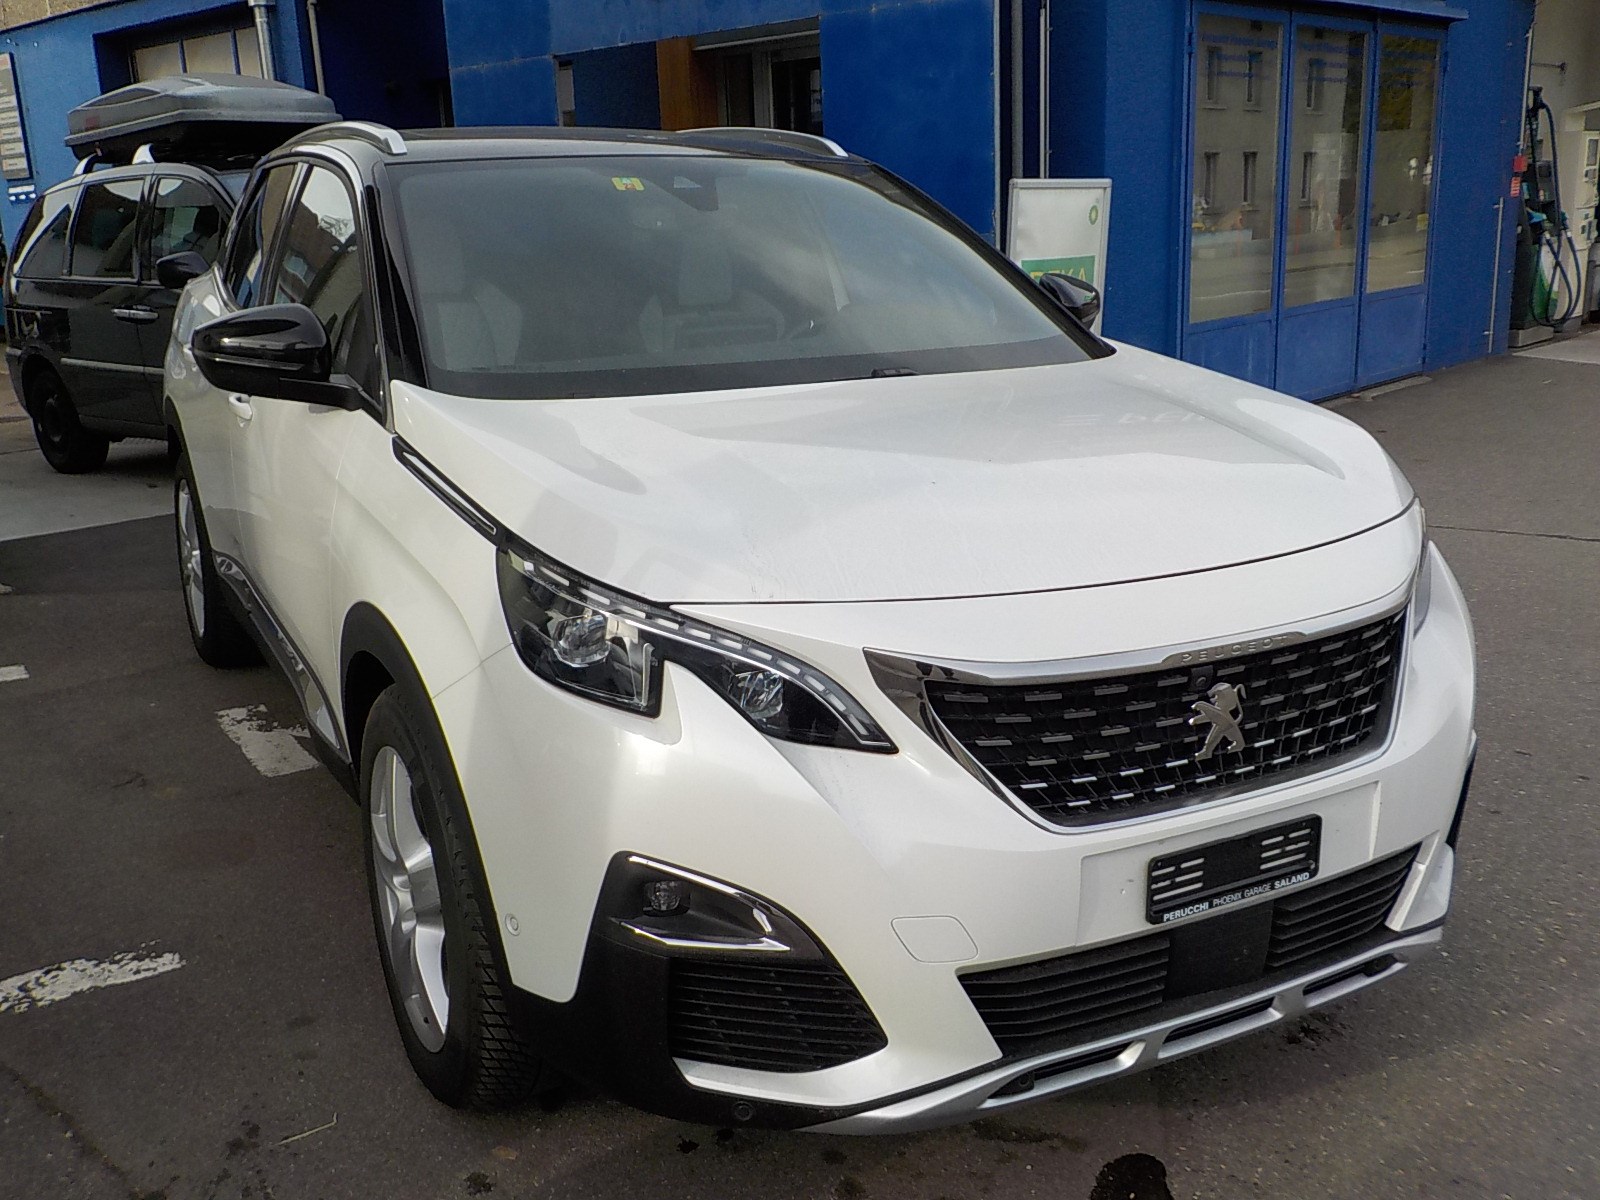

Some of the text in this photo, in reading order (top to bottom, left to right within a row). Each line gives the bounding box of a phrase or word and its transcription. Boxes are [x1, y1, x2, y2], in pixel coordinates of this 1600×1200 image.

[1181, 636, 1288, 663] PEUGEOT
[1163, 872, 1310, 922] PERUCCHI PHOENIX GARAGE SALAND
